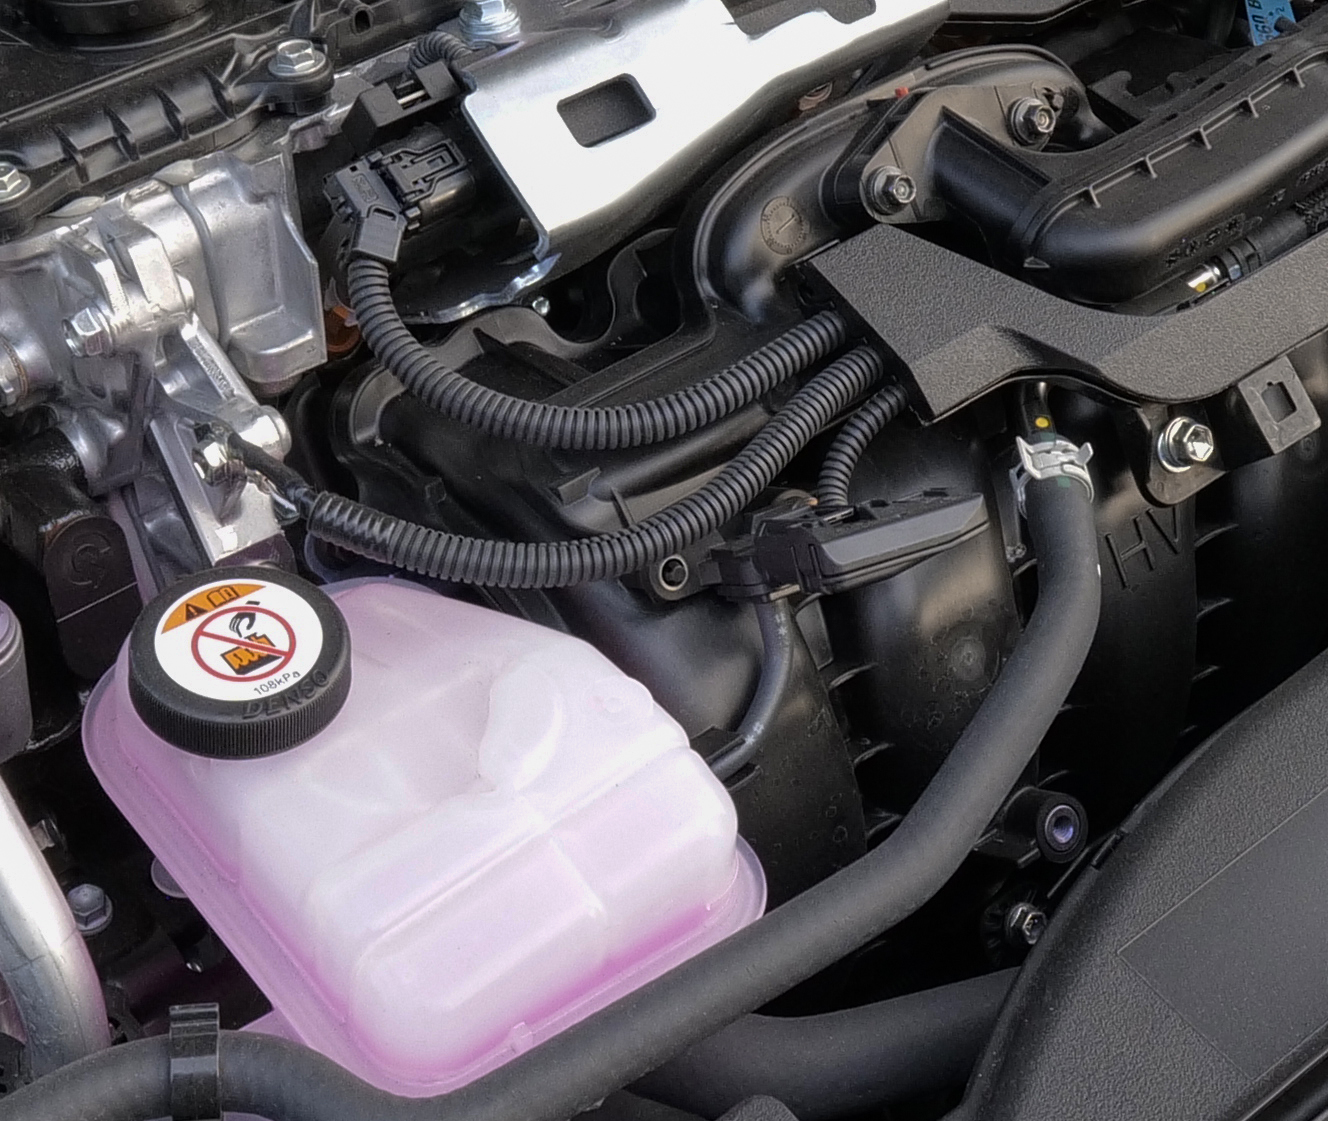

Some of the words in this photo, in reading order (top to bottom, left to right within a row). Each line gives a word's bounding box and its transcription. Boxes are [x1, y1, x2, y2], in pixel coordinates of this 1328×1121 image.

[1105, 505, 1185, 590] HV
[242, 668, 330, 720] DENSO
[253, 669, 302, 696] 108kPa
